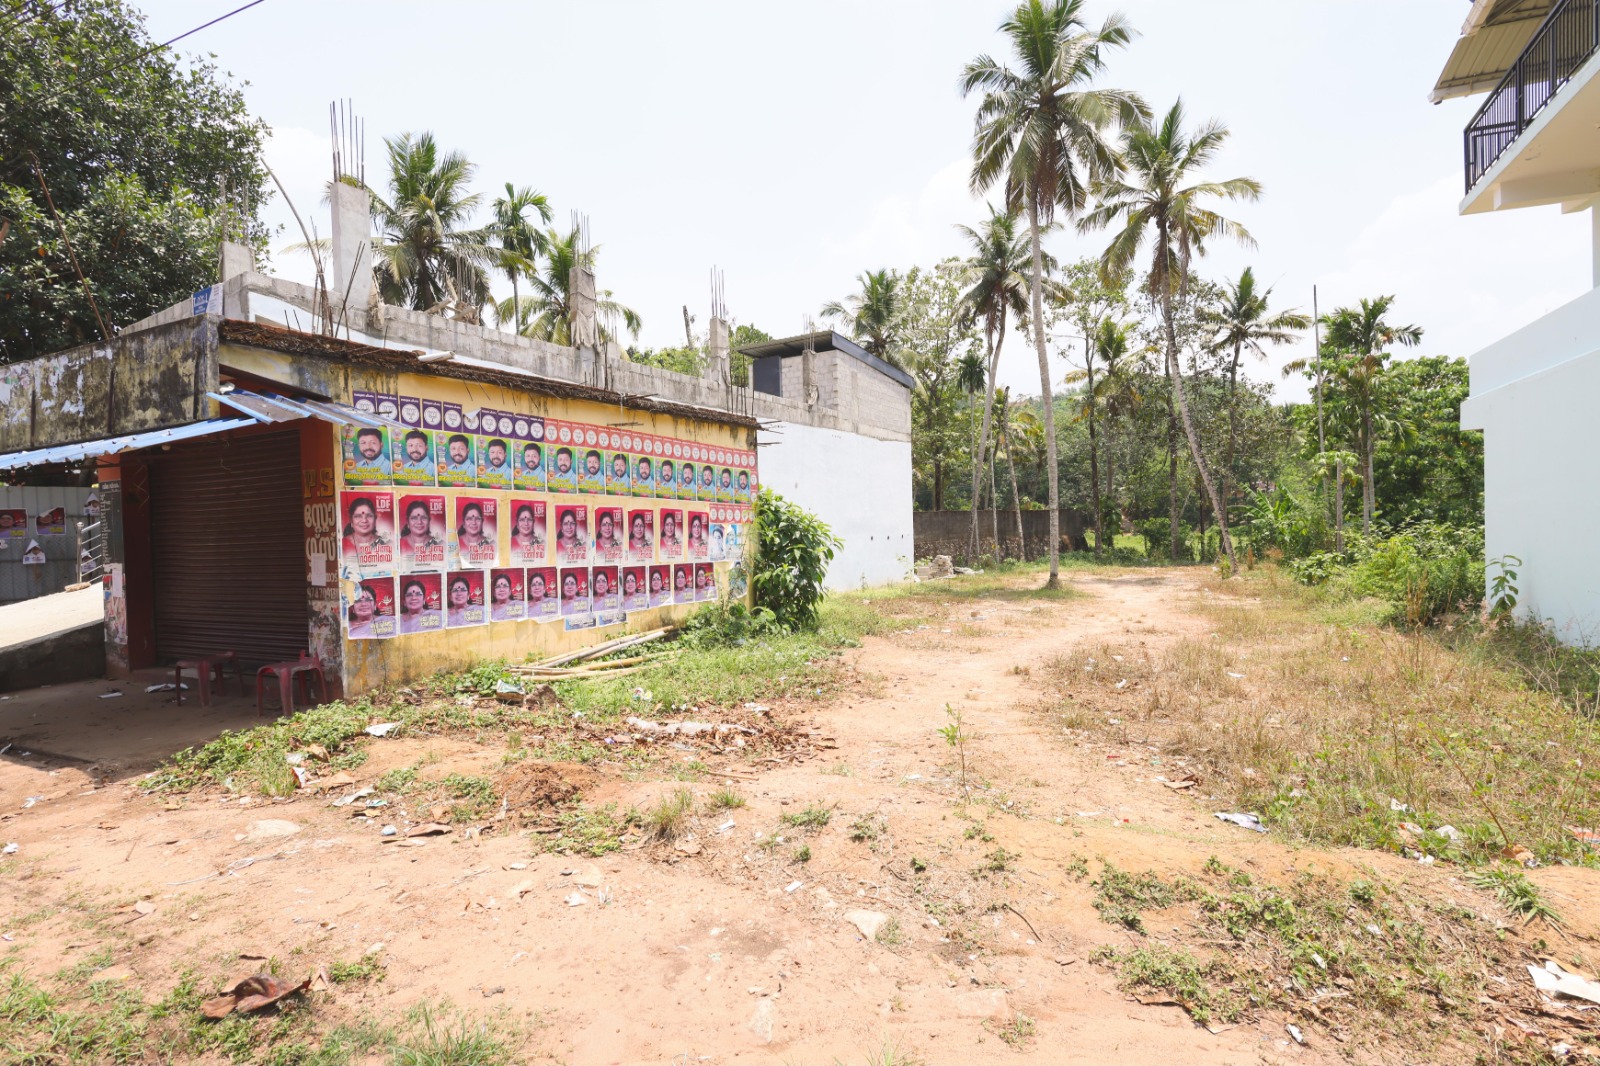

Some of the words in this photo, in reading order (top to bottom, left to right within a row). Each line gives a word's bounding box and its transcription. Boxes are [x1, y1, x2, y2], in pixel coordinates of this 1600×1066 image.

[376, 499, 391, 509] LDF
[429, 502, 443, 511] LDF
[483, 504, 495, 513] LDF
